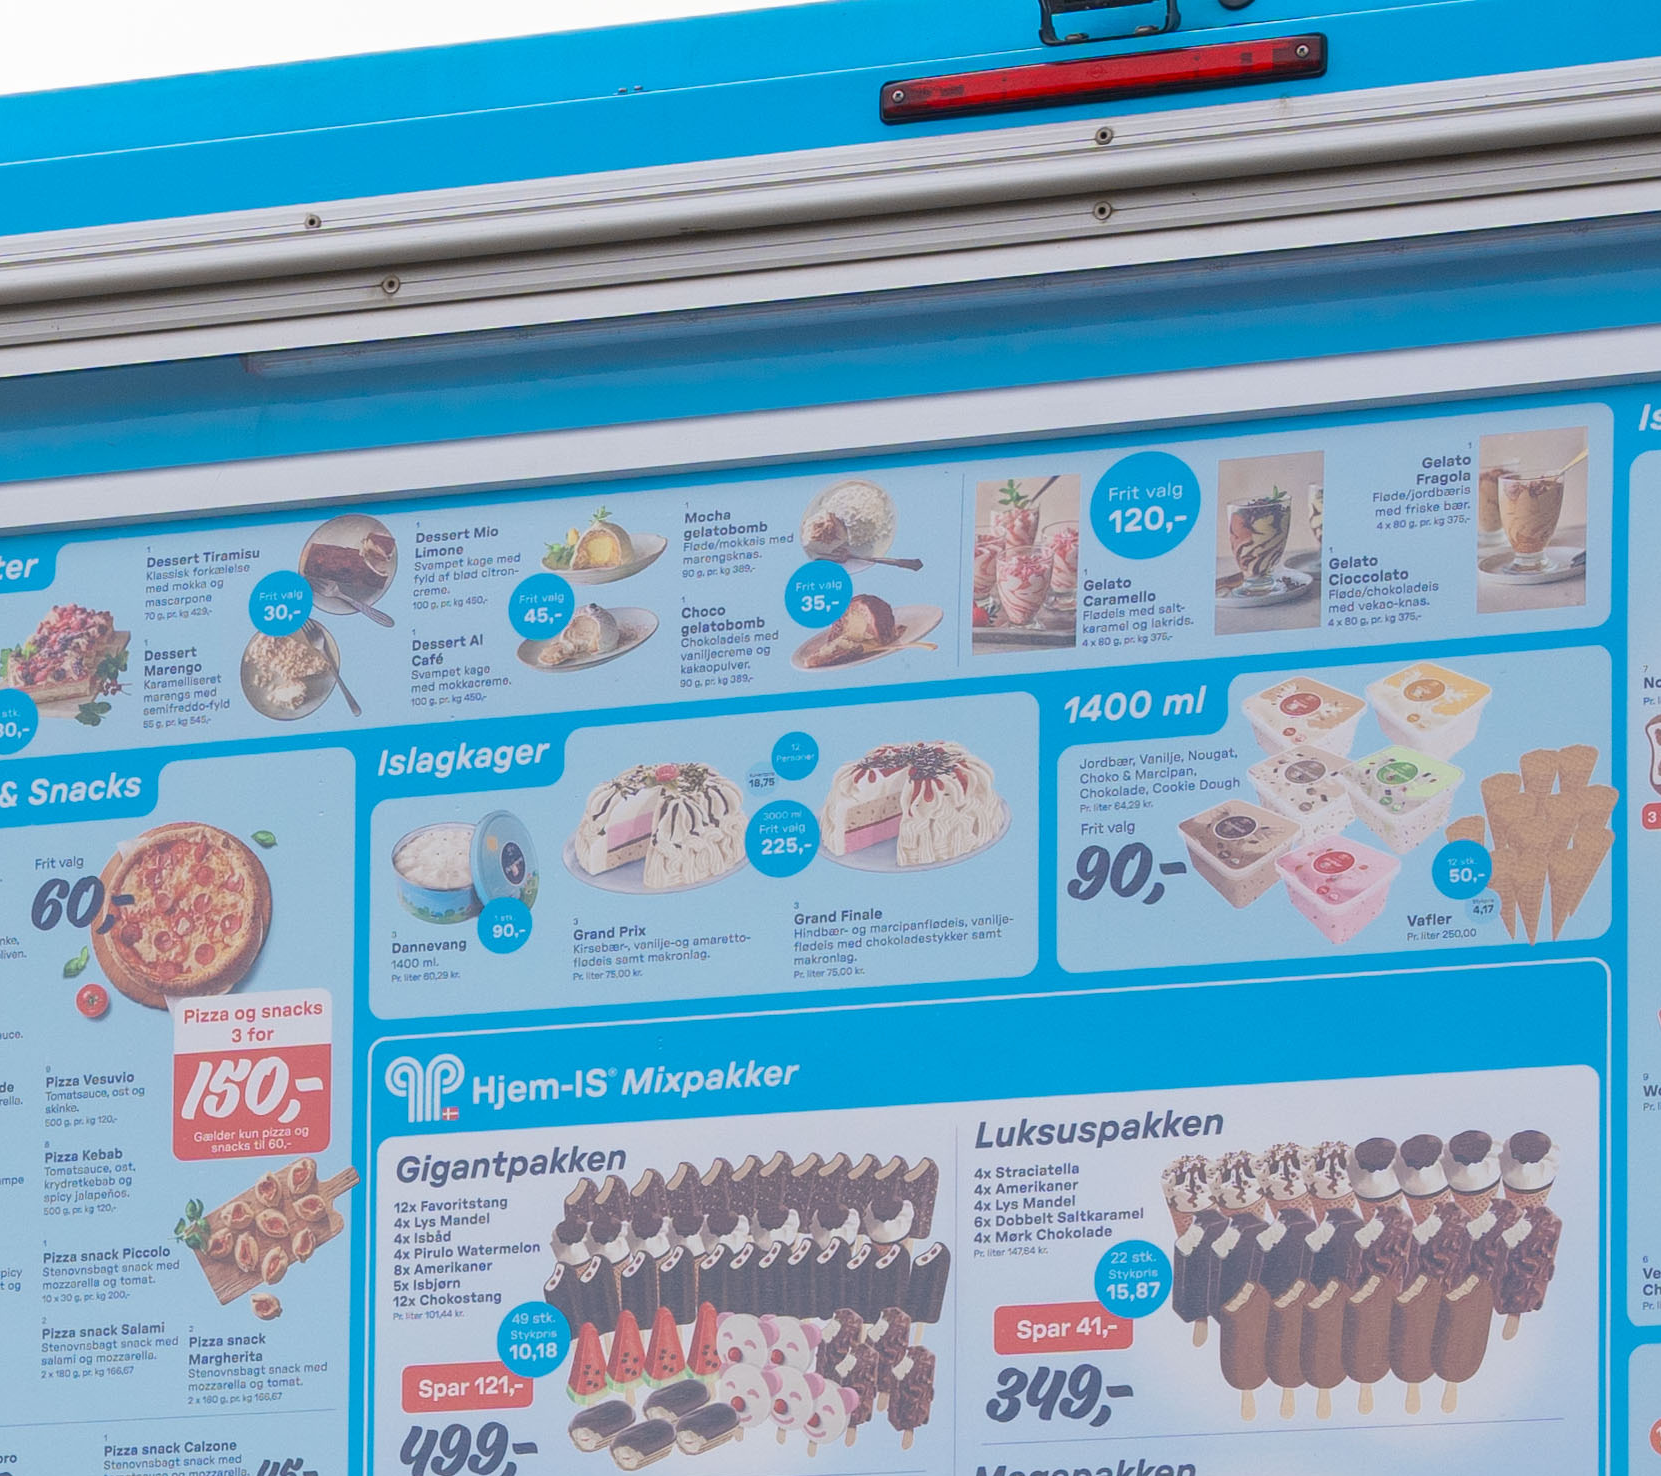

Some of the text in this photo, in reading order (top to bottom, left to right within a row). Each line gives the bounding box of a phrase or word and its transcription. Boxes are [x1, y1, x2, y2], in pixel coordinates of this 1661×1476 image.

[1109, 482, 1183, 501] Frit valg
[1108, 508, 1188, 539] 120,-
[146, 549, 259, 569] Dessert Tiramisu
[1329, 556, 1378, 569] Gelato
[1084, 578, 1131, 591] Gelato
[1329, 569, 1408, 586] Cioccolato
[1084, 591, 1156, 607] Caramello
[263, 604, 302, 622] 30,-
[1065, 685, 1206, 723] 1400 ml
[378, 743, 550, 778] Islagkager
[29, 773, 141, 805] Snacks
[761, 837, 812, 855] 225,-
[1067, 842, 1187, 904] 90,-
[1450, 868, 1485, 882] 50,-
[31, 875, 136, 936] 60,-
[1407, 914, 1452, 926] Vafler
[574, 925, 645, 940] Grand Prix
[392, 941, 466, 953] Dannevang
[185, 1001, 322, 1024] Pizza og snacks
[232, 1027, 274, 1042] 3 for
[622, 1060, 800, 1098] Mixpakker
[182, 1057, 323, 1123] 150,-
[975, 1110, 1223, 1148] Luksuspakken
[396, 1145, 627, 1189] Gigantpakken
[394, 1213, 489, 1230] 4x Lys Mandel
[512, 1312, 555, 1324] 49 stk.
[510, 1343, 557, 1361] 10,18
[419, 1376, 523, 1401] Spar 121,-
[986, 1364, 1133, 1427] 349,-
